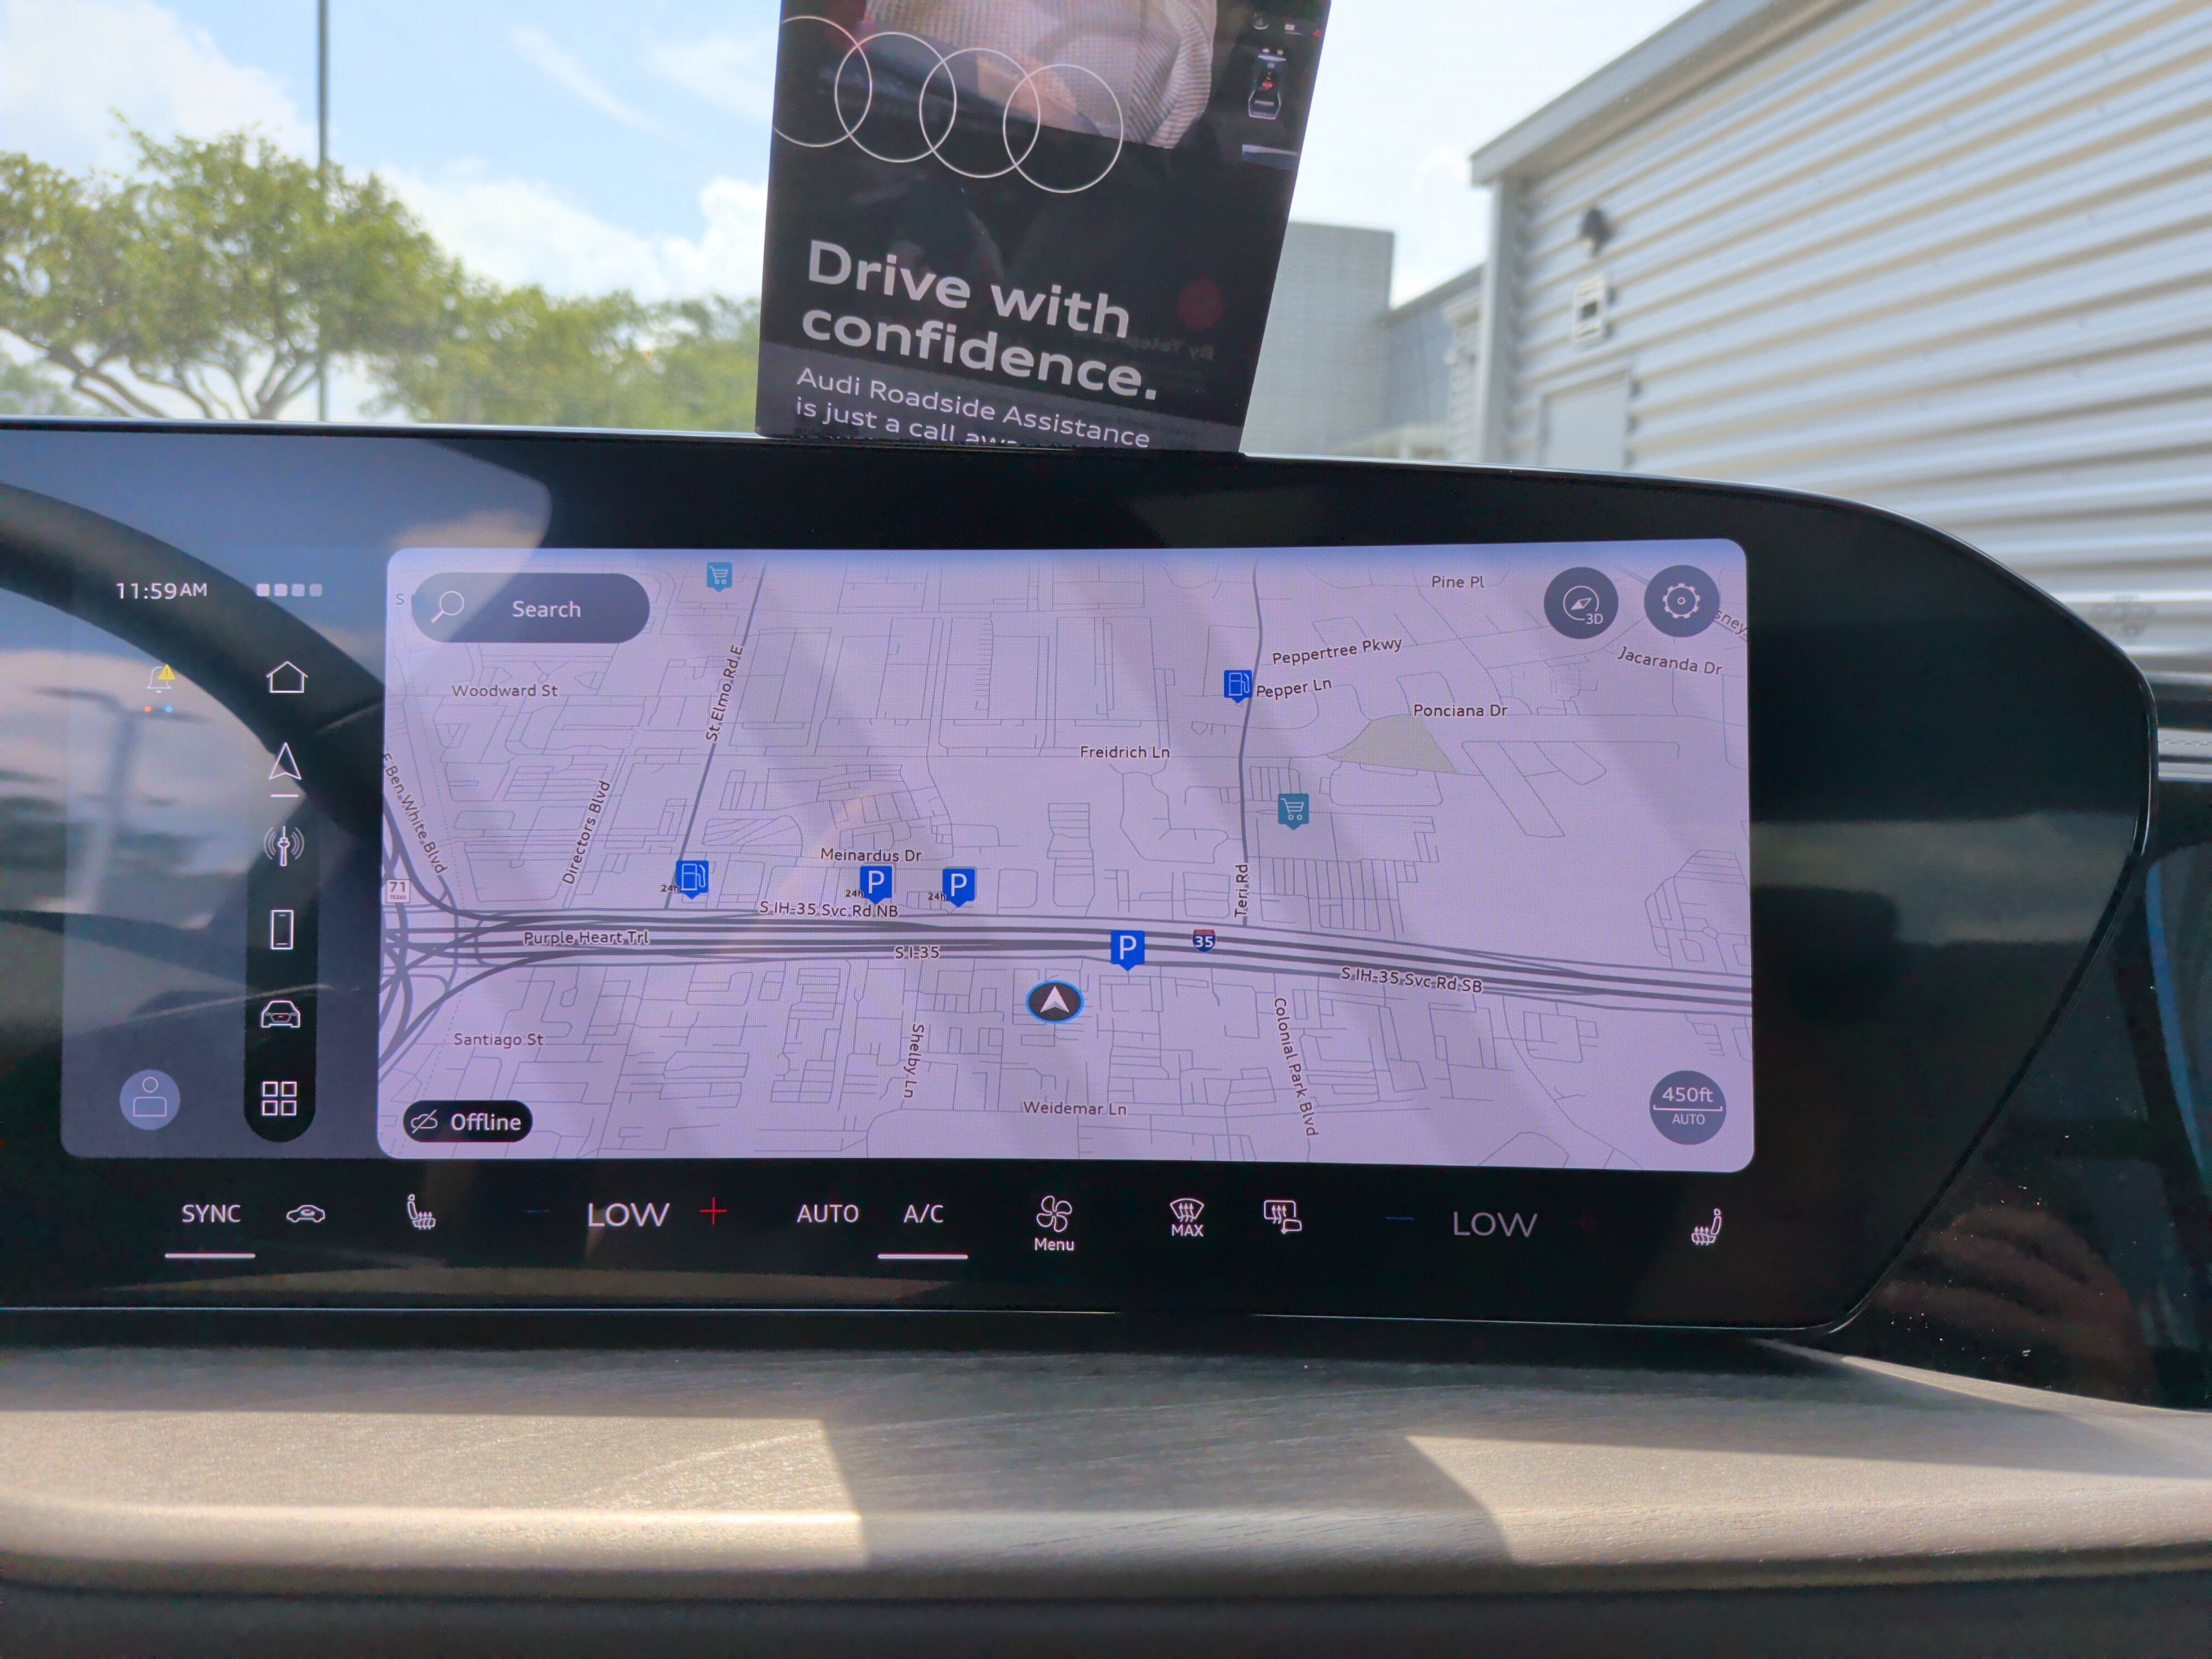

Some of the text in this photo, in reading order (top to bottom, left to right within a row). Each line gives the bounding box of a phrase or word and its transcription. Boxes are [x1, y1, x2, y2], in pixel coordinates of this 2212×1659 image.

[808, 240, 1129, 338] Drive with
[802, 310, 1157, 400] confidence.
[797, 367, 1150, 448] Audi Roadside Assistance
[796, 397, 817, 418] is
[822, 402, 877, 430] just
[885, 418, 899, 433] a
[910, 422, 954, 442] call
[1432, 576, 1485, 588] Pine Pl
[395, 593, 405, 605] S
[512, 601, 581, 618] Search
[1585, 614, 1603, 624] 3D
[1273, 638, 1402, 665] Peppertree Pkwy
[1618, 646, 1723, 675] Jacaranda Dr
[452, 685, 559, 697] Woodward St
[706, 644, 743, 742] St Elmo Rd E
[1256, 678, 1332, 700] Pepper Ln
[1413, 704, 1508, 717] Ponciana Dr
[1081, 746, 1170, 758] Freidrich Ln
[385, 765, 404, 794] Ben
[402, 795, 427, 840] White
[423, 841, 448, 874] Blvd
[562, 780, 610, 885] Directors Blvd
[821, 848, 922, 862] Meinardus Dr
[390, 881, 405, 893] 71
[868, 870, 885, 894] P
[951, 873, 967, 896] P
[1235, 864, 1249, 918] Teri Rd
[846, 890, 864, 898] 24h
[928, 893, 946, 901] 24h
[760, 901, 898, 917] S IH-35 Svc Rd NB
[524, 931, 649, 947] Purple Heart Trl
[1119, 936, 1137, 959] P
[1195, 936, 1214, 948] 35
[895, 947, 939, 959] S I-35
[1341, 967, 1483, 993] S IH-35 Svc Rd SB
[454, 1034, 544, 1048] Santiago St
[904, 1024, 925, 1098] Shelby Ln
[1274, 998, 1319, 1136] Colonial Park Blvd
[1662, 1087, 1713, 1102] 450ft
[1023, 1101, 1127, 1115] Weidemar Ln
[451, 1113, 521, 1130] Offline
[1672, 1114, 1705, 1125] AUTO
[181, 1204, 241, 1223] SYNC
[587, 1202, 670, 1228] LOW
[796, 1204, 859, 1224] AUTO
[903, 1204, 944, 1224] A/C
[1171, 1224, 1204, 1237] MAX
[1454, 1212, 1538, 1237] LOW
[1034, 1238, 1075, 1252] Menu
